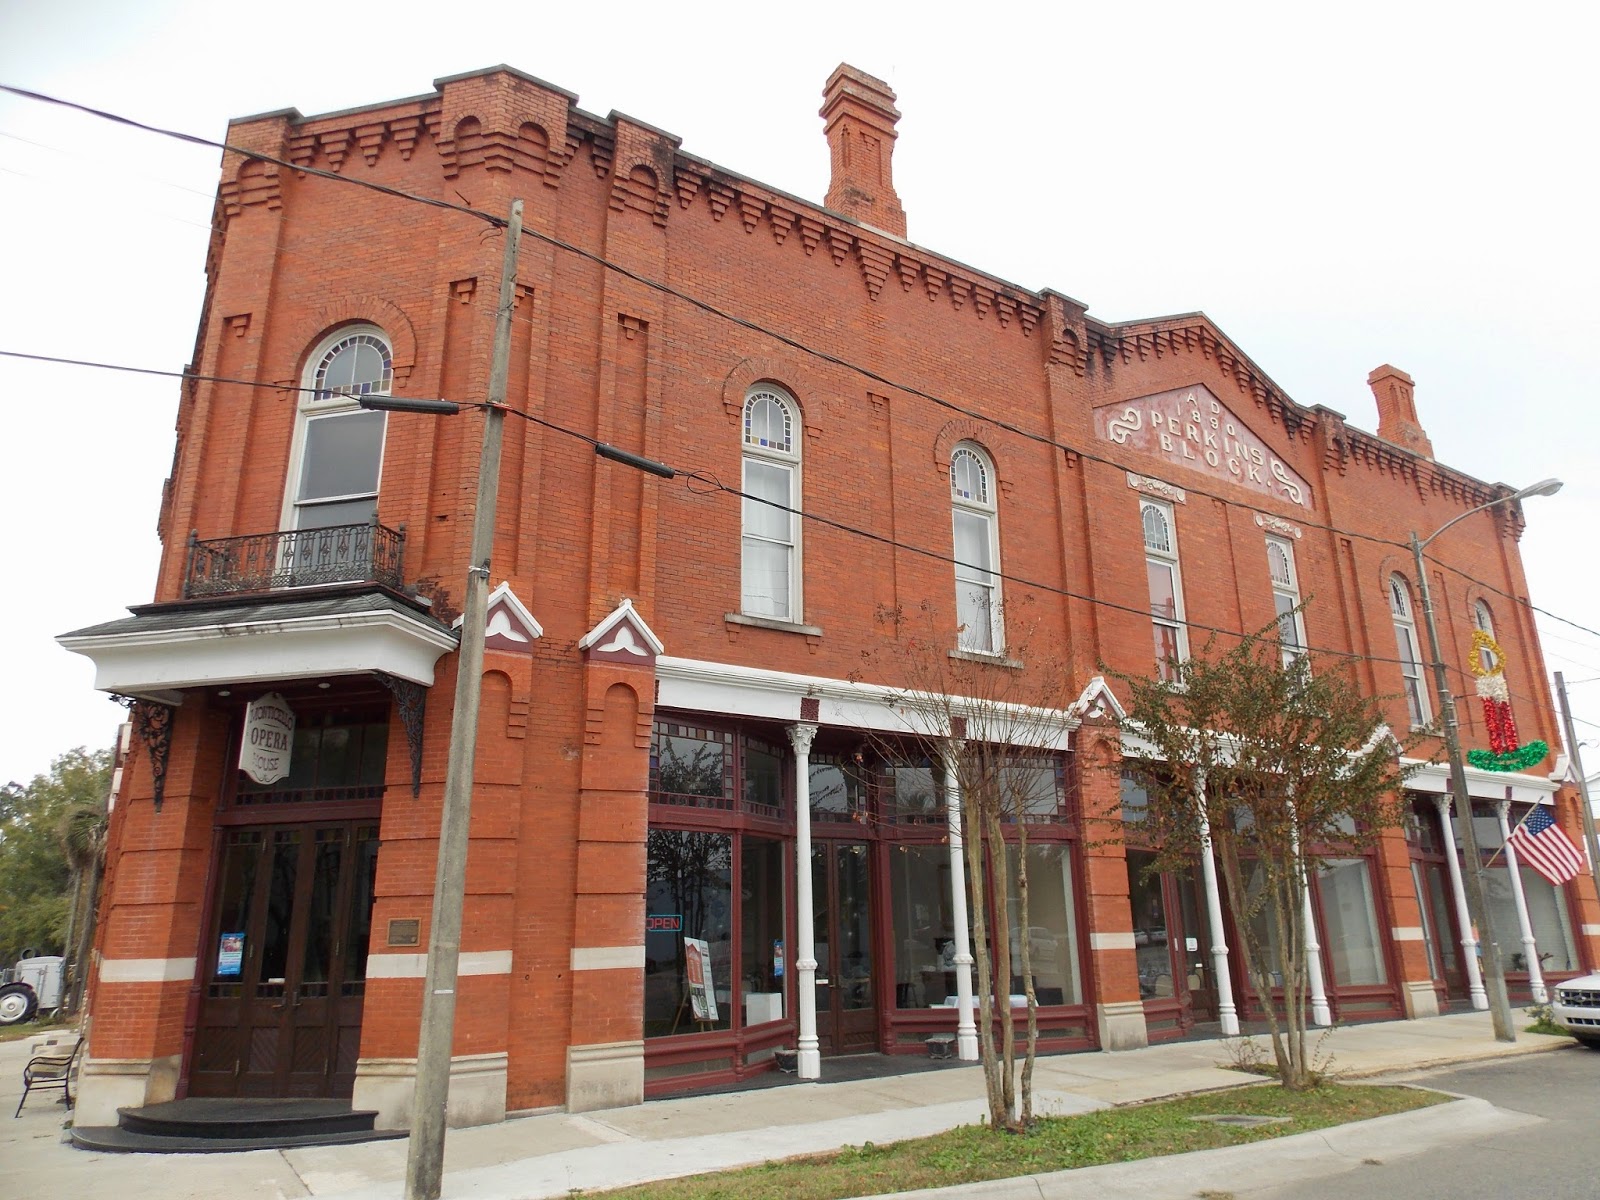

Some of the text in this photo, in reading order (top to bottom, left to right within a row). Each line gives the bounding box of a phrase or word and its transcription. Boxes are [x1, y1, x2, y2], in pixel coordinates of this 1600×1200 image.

[1177, 404, 1236, 436] 1890
[1150, 410, 1265, 466] PERKINS
[250, 705, 294, 732] MONTICELLO
[251, 727, 288, 752] OPERA
